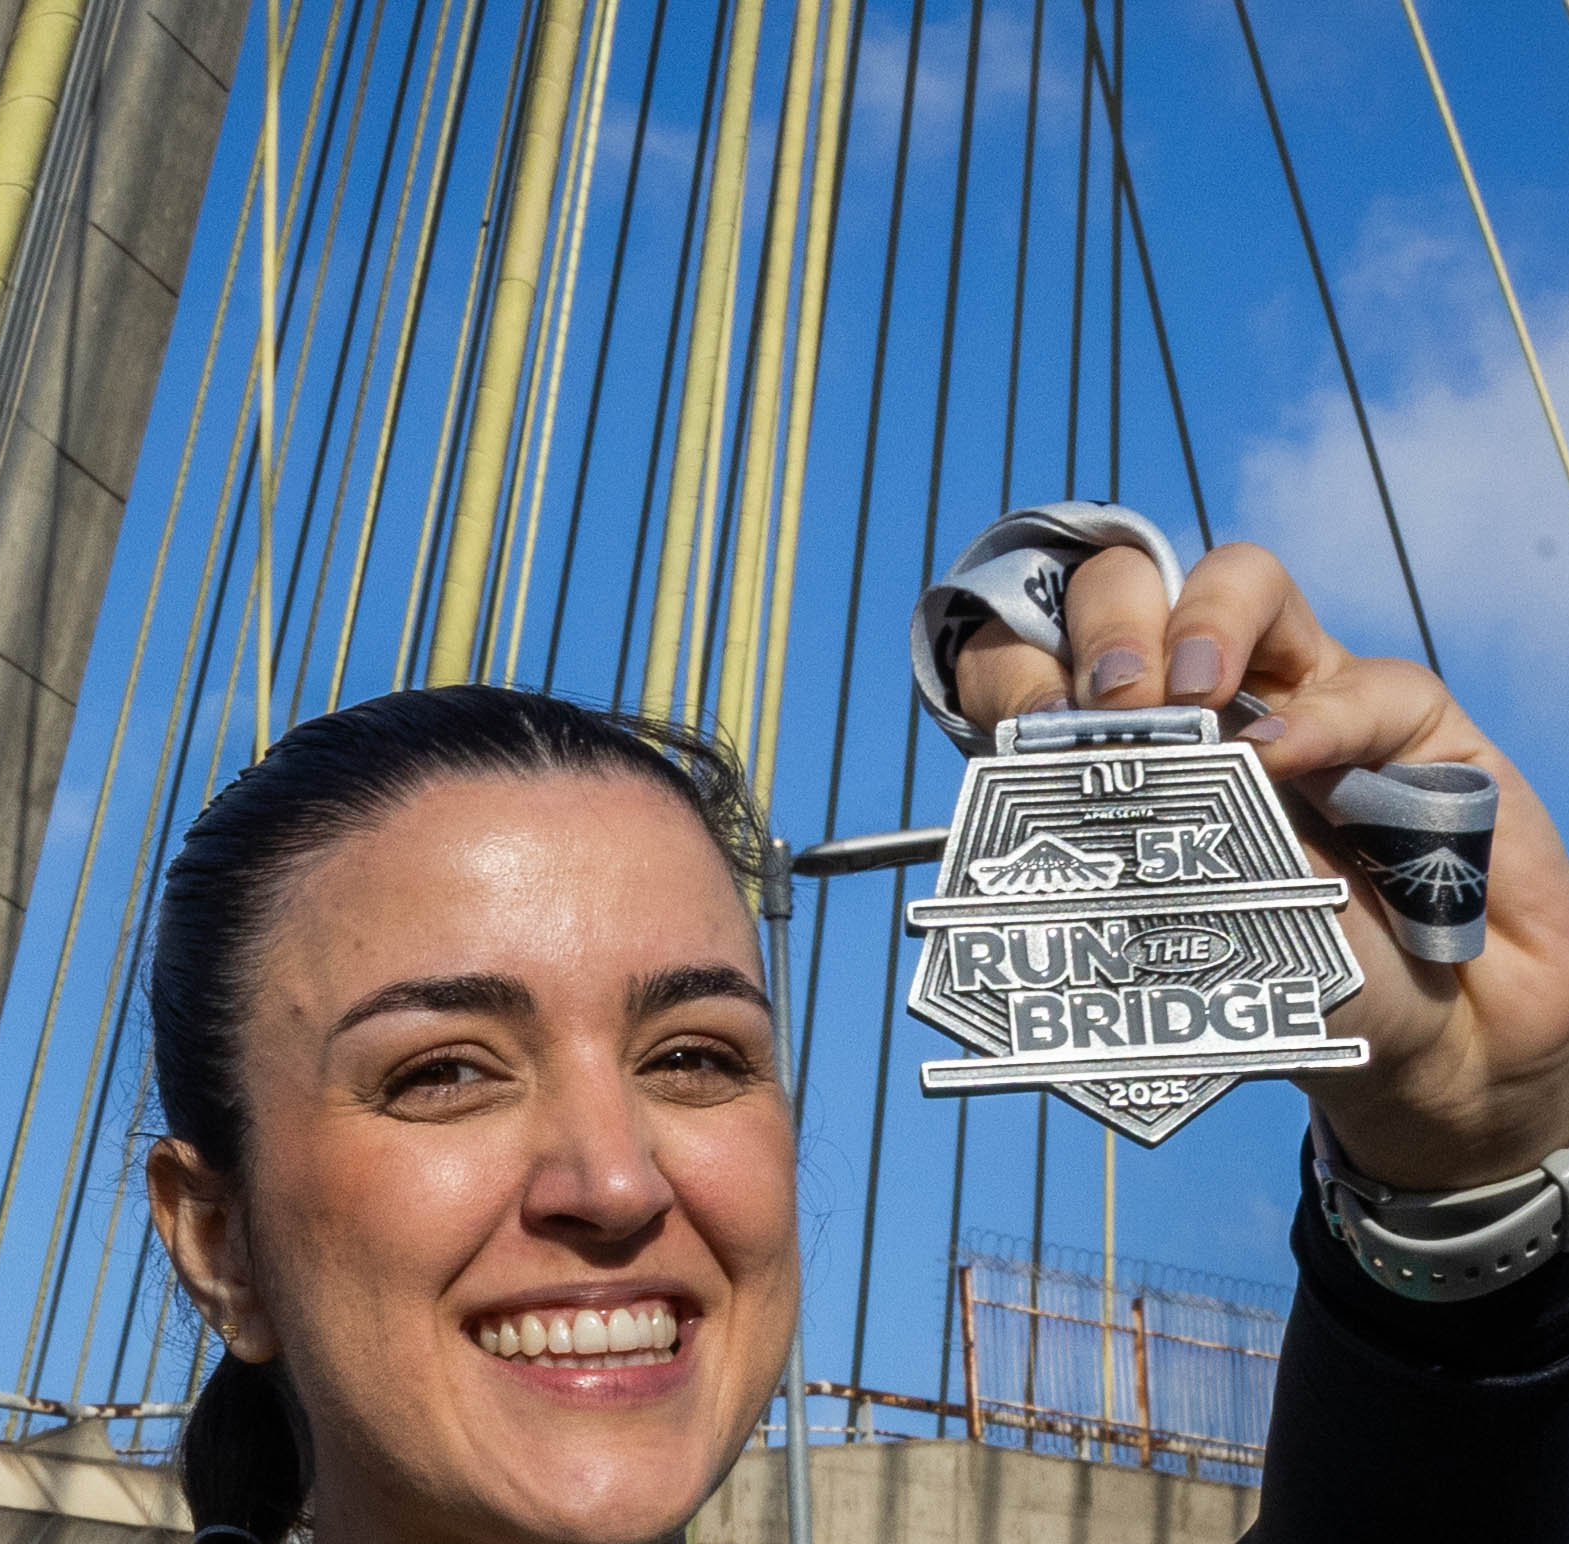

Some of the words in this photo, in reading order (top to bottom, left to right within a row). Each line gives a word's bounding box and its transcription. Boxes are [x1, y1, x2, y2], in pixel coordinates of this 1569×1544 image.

[1137, 823, 1240, 882] 5K
[949, 920, 1133, 991] RUN
[1142, 935, 1212, 964] THE
[1010, 977, 1325, 1055] BRIDGE
[1108, 1080, 1189, 1107] 2025
